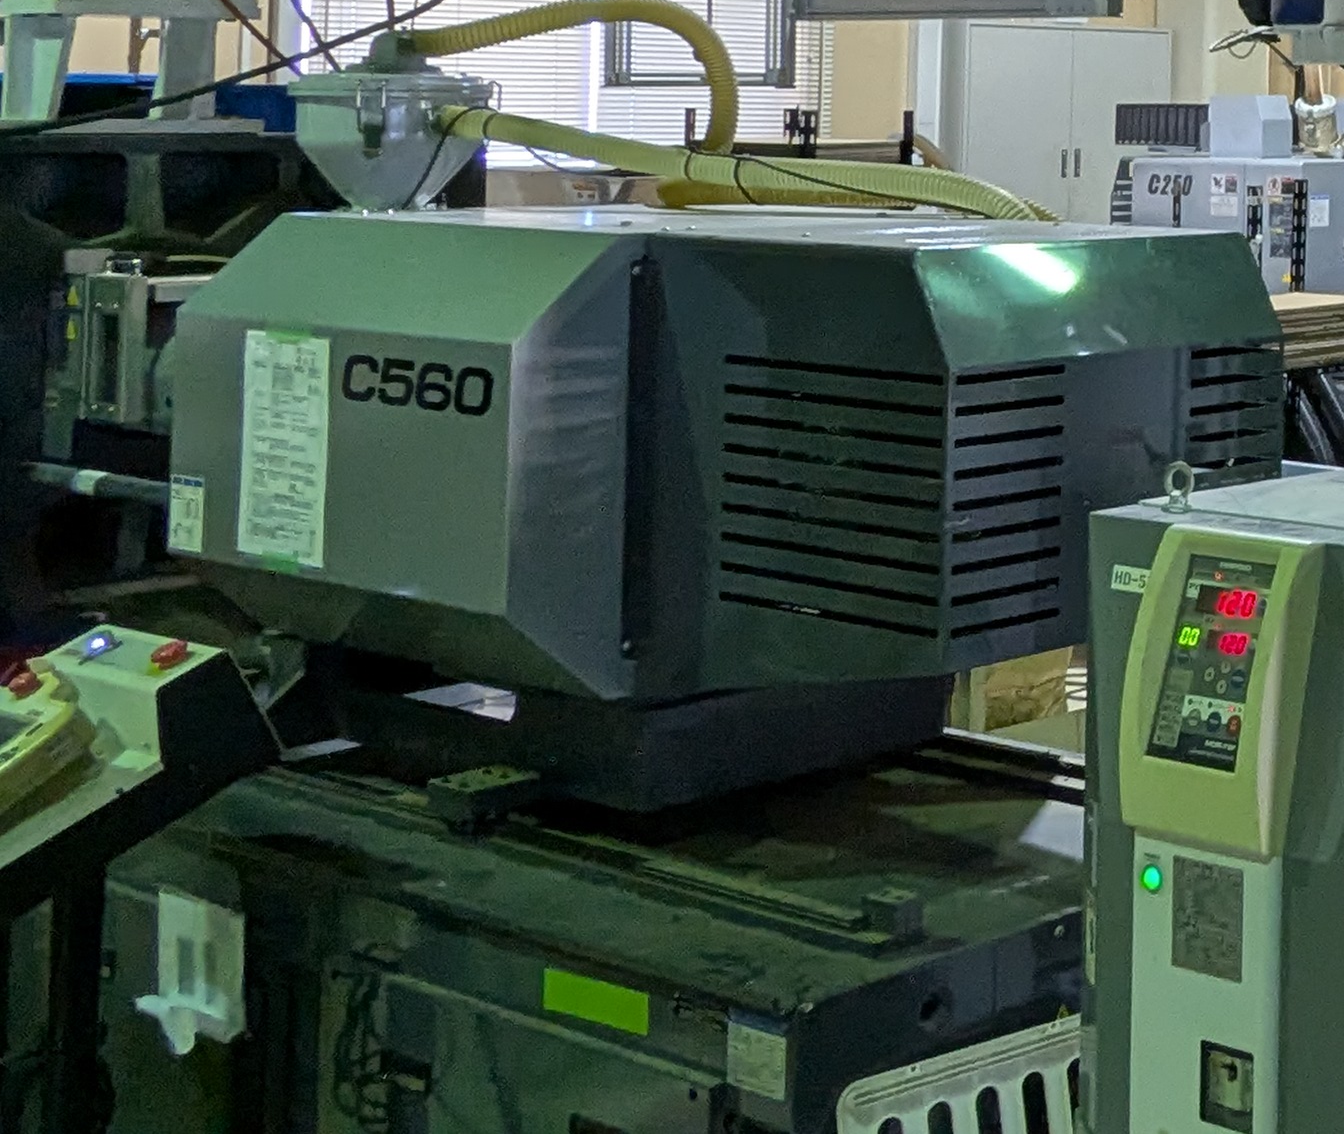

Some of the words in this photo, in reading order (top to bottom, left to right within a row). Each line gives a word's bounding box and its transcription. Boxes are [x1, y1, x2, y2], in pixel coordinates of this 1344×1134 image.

[342, 355, 494, 416] C560
[1114, 570, 1150, 589] HD-5
[1217, 590, 1257, 618] 120
